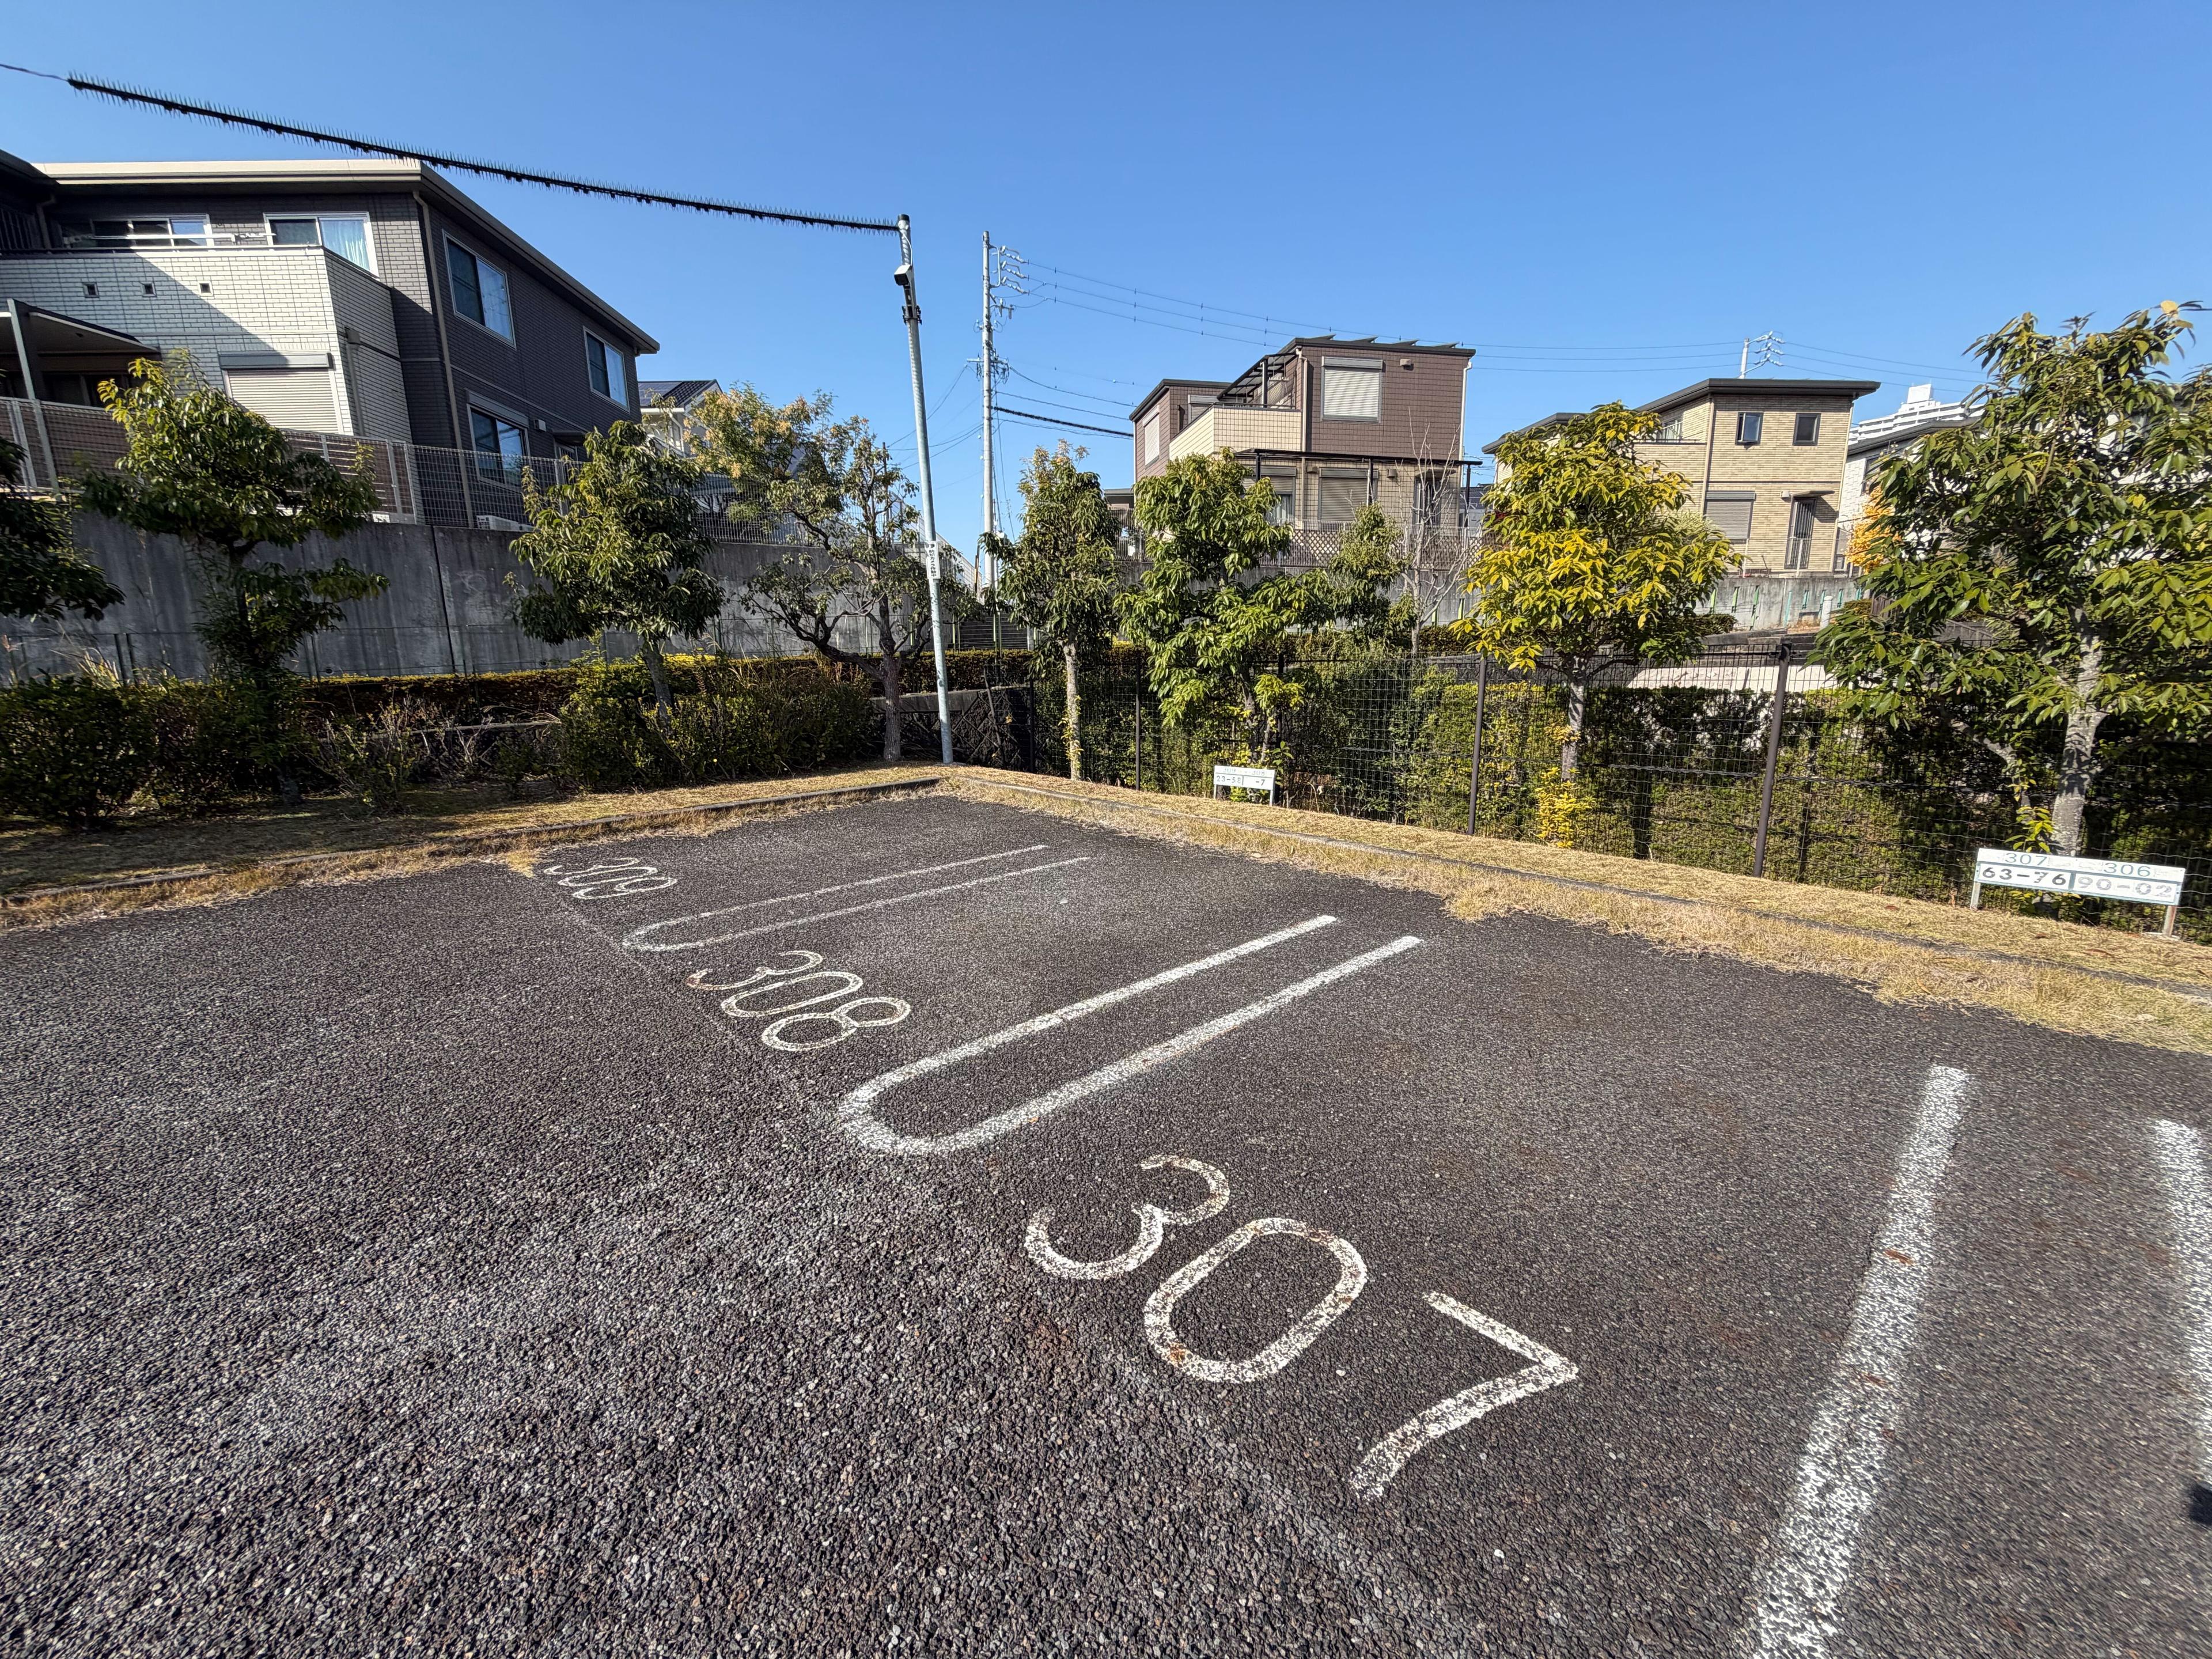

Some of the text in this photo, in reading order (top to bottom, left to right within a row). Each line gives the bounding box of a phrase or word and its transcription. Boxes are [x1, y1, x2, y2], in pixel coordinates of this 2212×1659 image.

[2005, 853, 2047, 865] 307
[2104, 862, 2152, 877] 306
[543, 857, 677, 900] 309
[1982, 867, 2067, 885] 63-76
[2077, 876, 2172, 897] 90-02
[687, 950, 911, 1051] 308
[1024, 1153, 1579, 1499] 307
